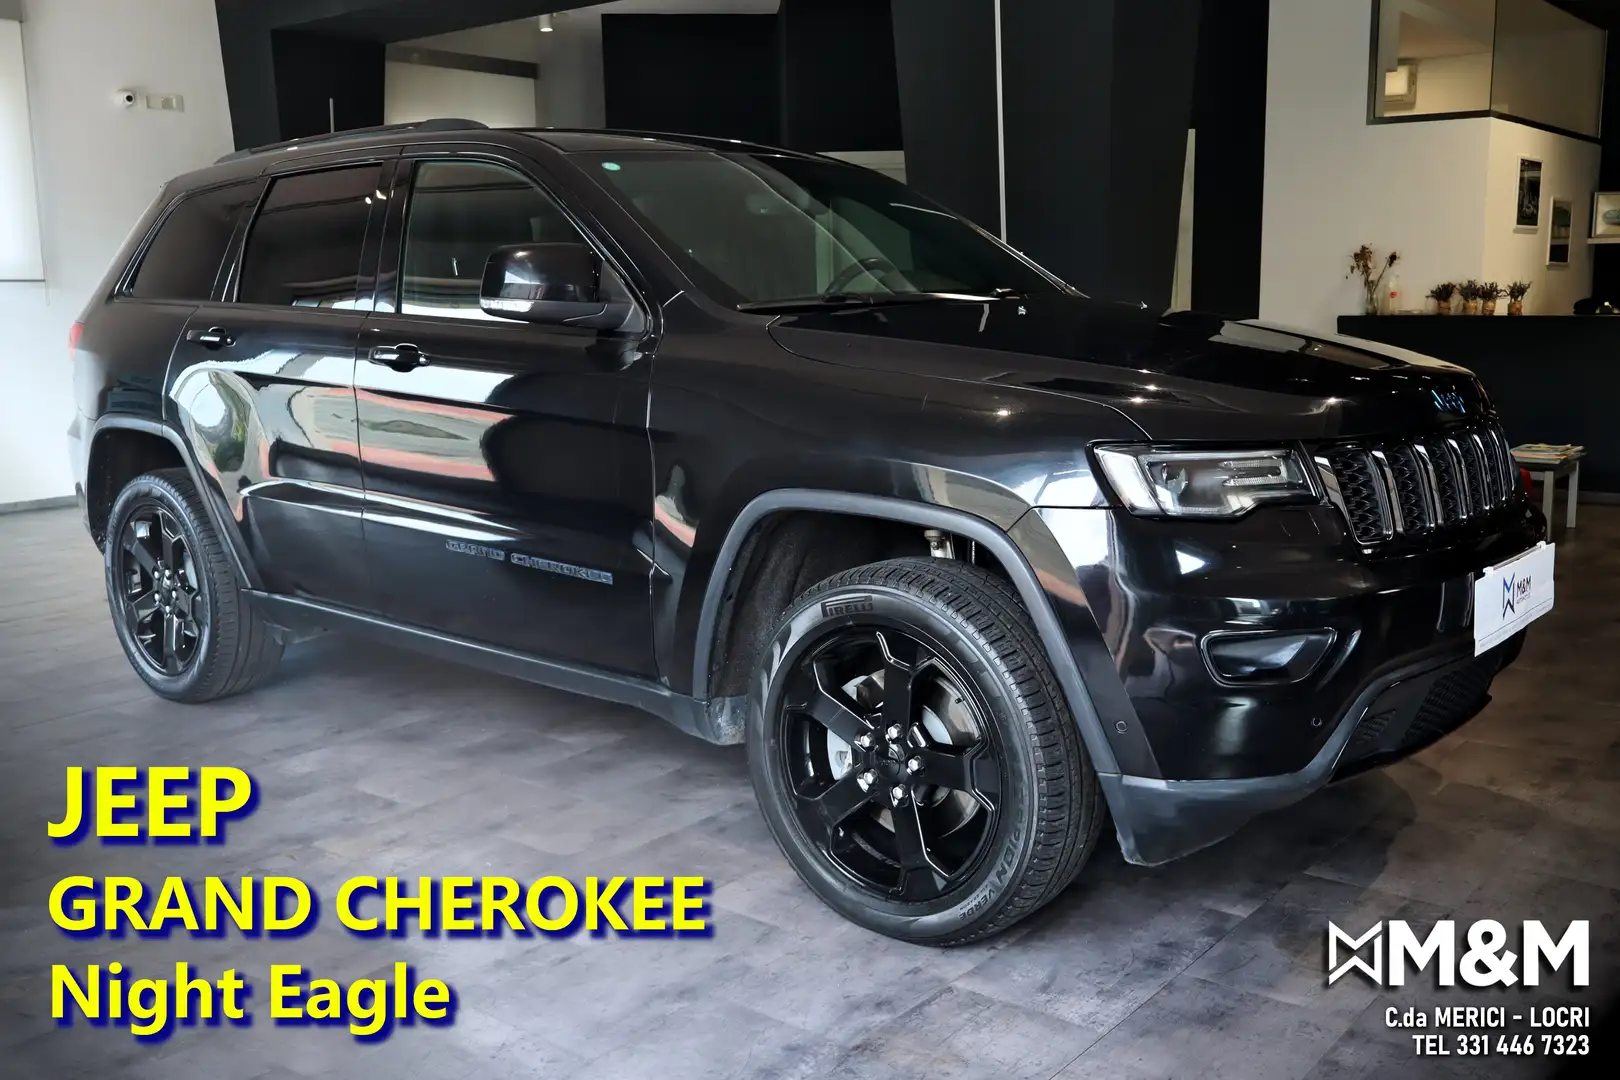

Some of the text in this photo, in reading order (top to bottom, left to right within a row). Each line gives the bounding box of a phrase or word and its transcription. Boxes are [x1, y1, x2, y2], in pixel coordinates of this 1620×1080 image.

[1516, 575, 1532, 598] M&M
[820, 594, 875, 618] PIRELLI
[958, 888, 996, 921] VERDE
